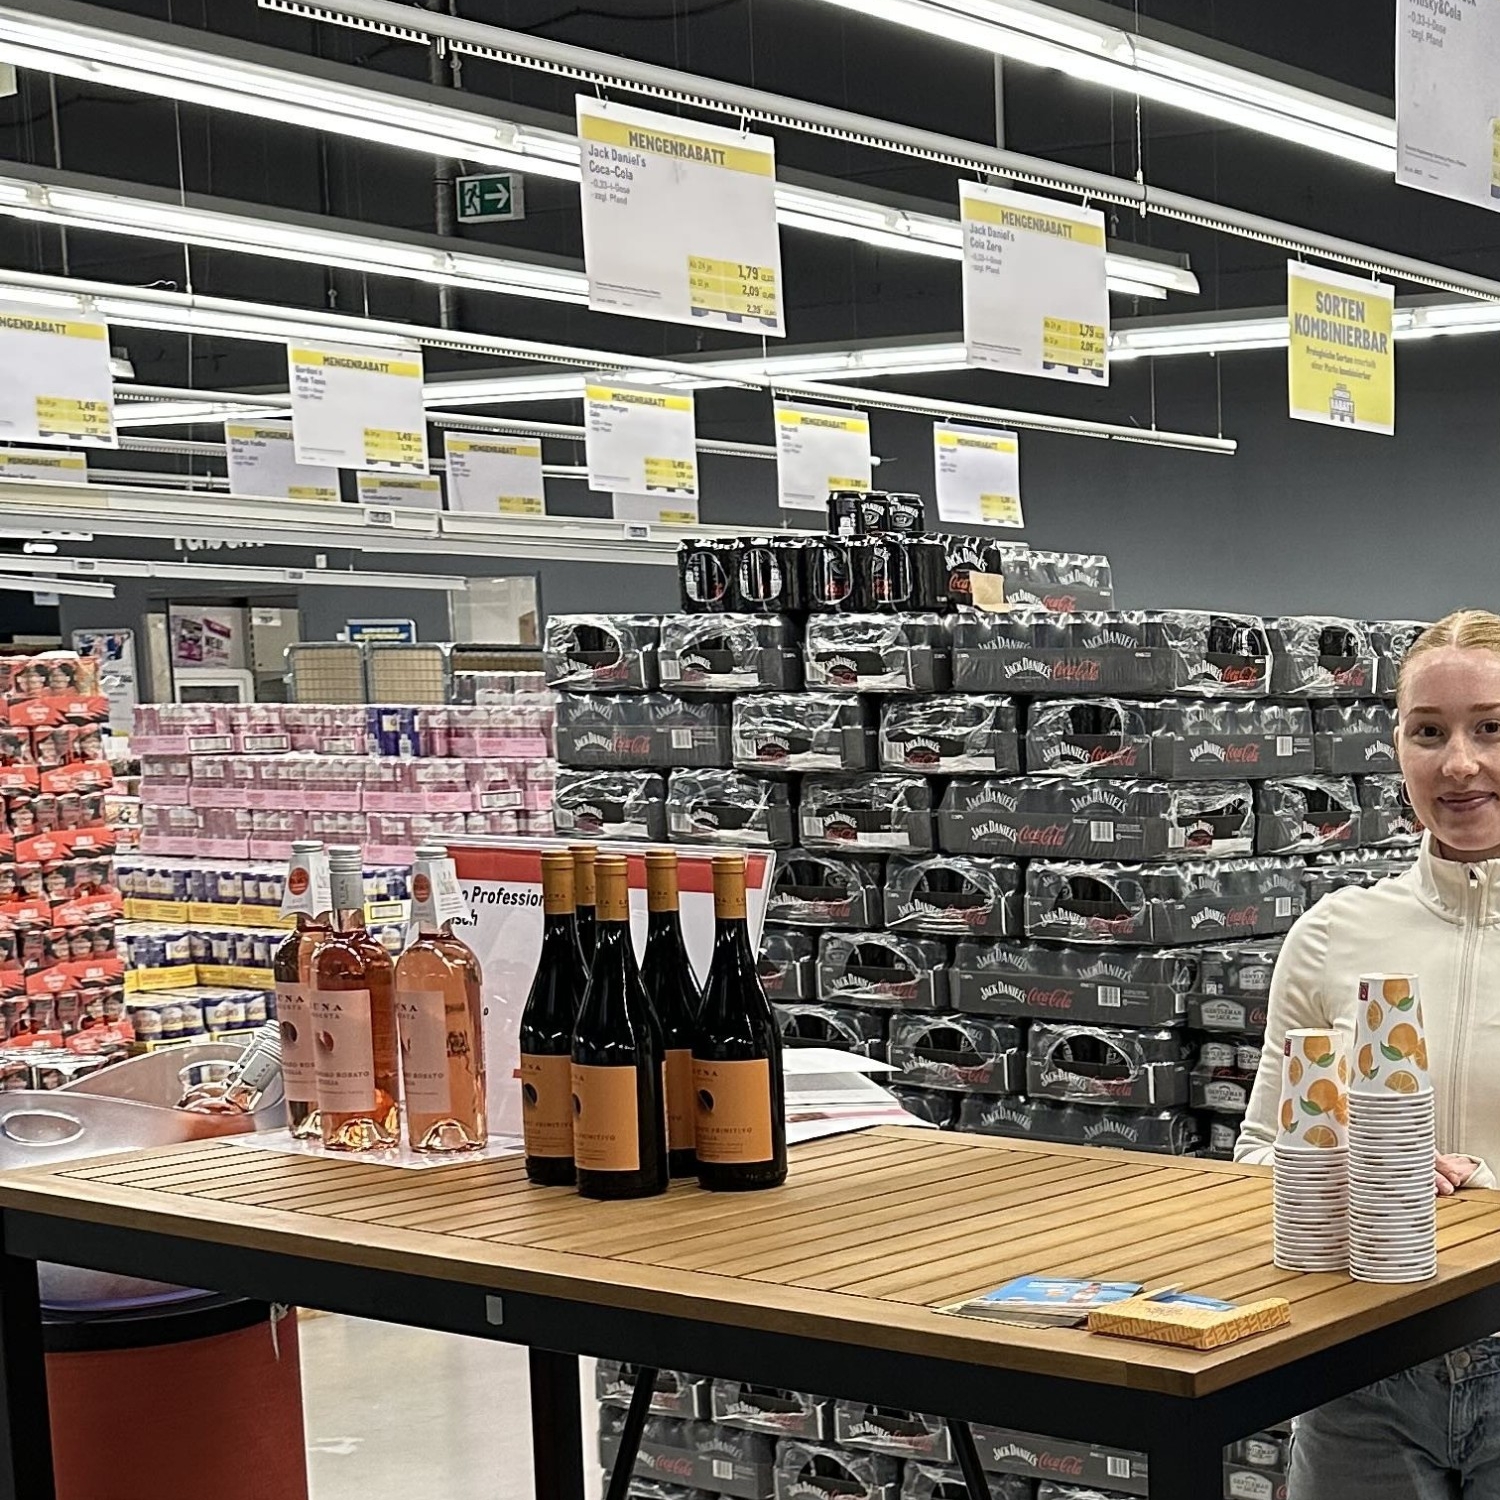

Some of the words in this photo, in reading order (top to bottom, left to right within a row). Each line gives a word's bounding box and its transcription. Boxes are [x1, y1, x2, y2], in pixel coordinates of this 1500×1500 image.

[588, 144, 609, 161] Jack
[612, 148, 646, 168] Daniel's
[629, 131, 726, 165] MENGENRABATT
[589, 160, 634, 181] Coca-Cola
[970, 223, 986, 237] Jack
[1001, 210, 1072, 238] MENGENRABATT
[987, 240, 1002, 253] Zero
[1316, 290, 1365, 323] SORTEN
[1294, 312, 1389, 355] KOMBINIERBAR
[323, 356, 389, 374] MENGENRABATT
[1018, 824, 1070, 848] Coca-Cola
